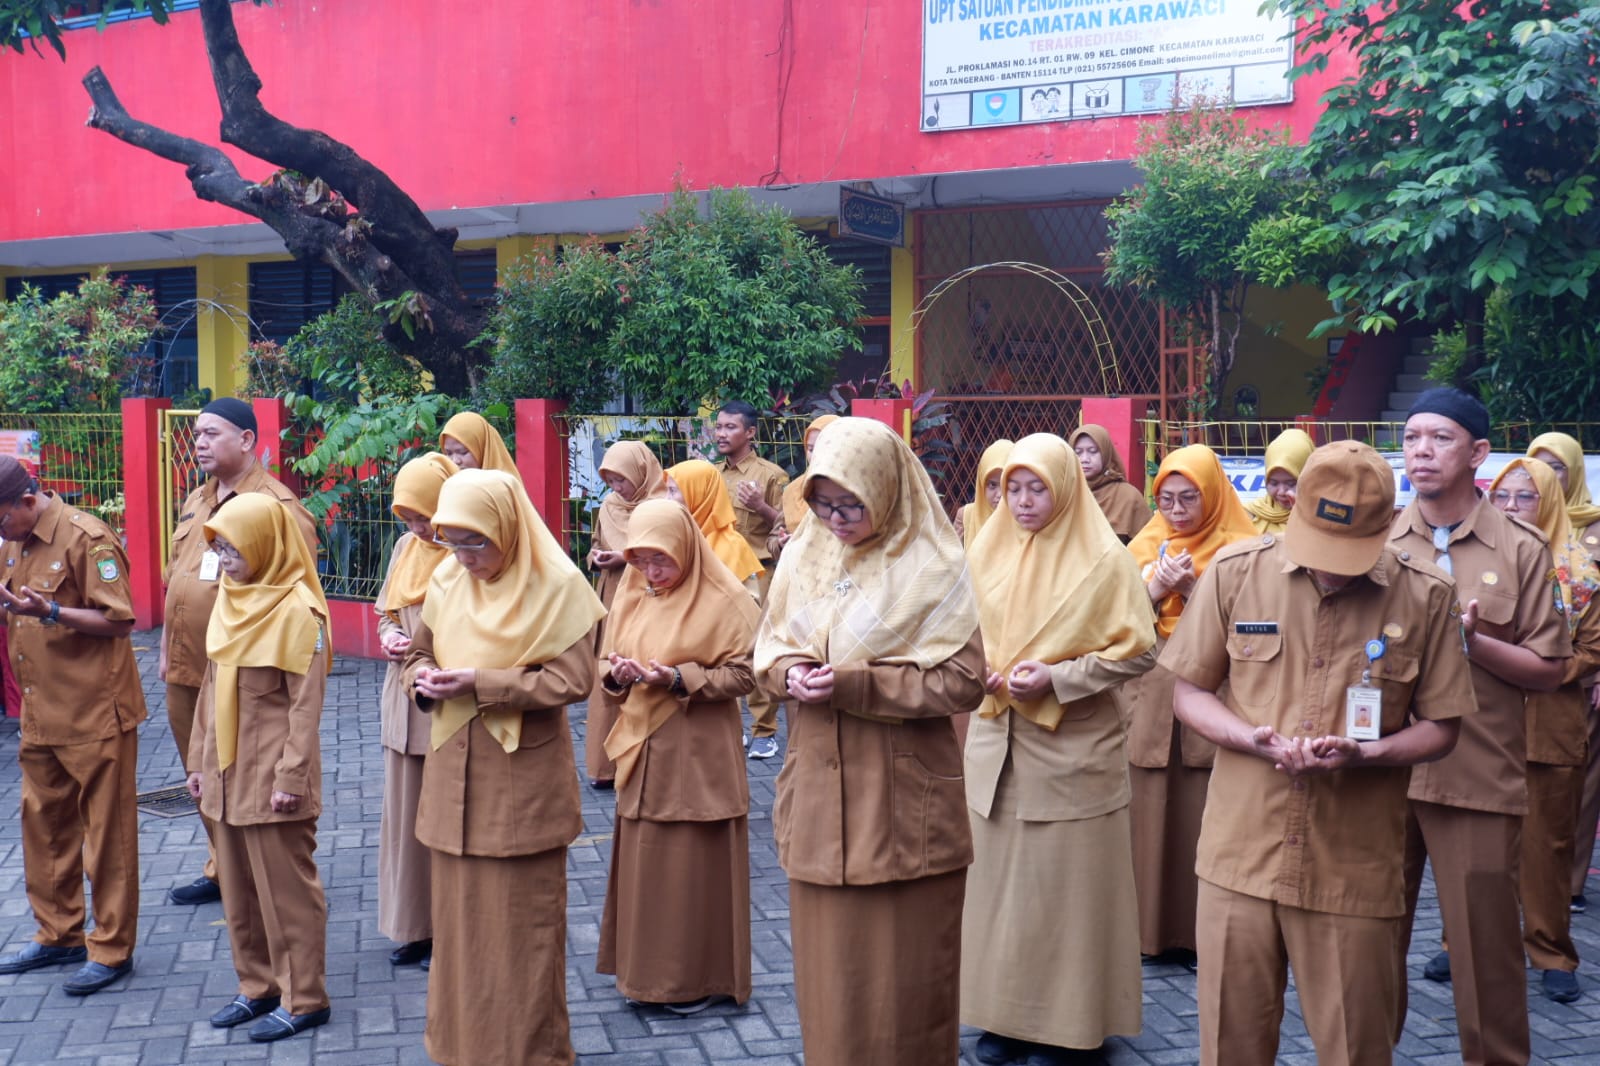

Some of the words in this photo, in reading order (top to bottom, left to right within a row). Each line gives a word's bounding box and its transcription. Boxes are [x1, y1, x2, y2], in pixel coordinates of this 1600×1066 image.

[929, 0, 955, 24] UPT
[979, 10, 1102, 41] KECAMATAN
[1109, 0, 1226, 27] KARAWACI
[929, 77, 948, 87] KOTA
[950, 74, 995, 85] TANGERANG
[1001, 71, 1031, 81] BANTEN
[1033, 67, 1057, 77] 15114
[1059, 66, 1073, 75] TLP
[1074, 64, 1095, 75] (021)
[1138, 56, 1164, 66] Email:
[945, 64, 956, 74] JL.
[958, 60, 1011, 73] PROKLAMASI
[1039, 56, 1052, 64] RT.
[1054, 54, 1065, 63] 01
[1066, 53, 1082, 62] RW.
[1084, 51, 1095, 60] 09
[1099, 49, 1118, 58] KEL.
[1120, 45, 1155, 56] CIMONE
[1159, 39, 1213, 52] KECAMATAN
[1215, 33, 1265, 46] KARAWACI
